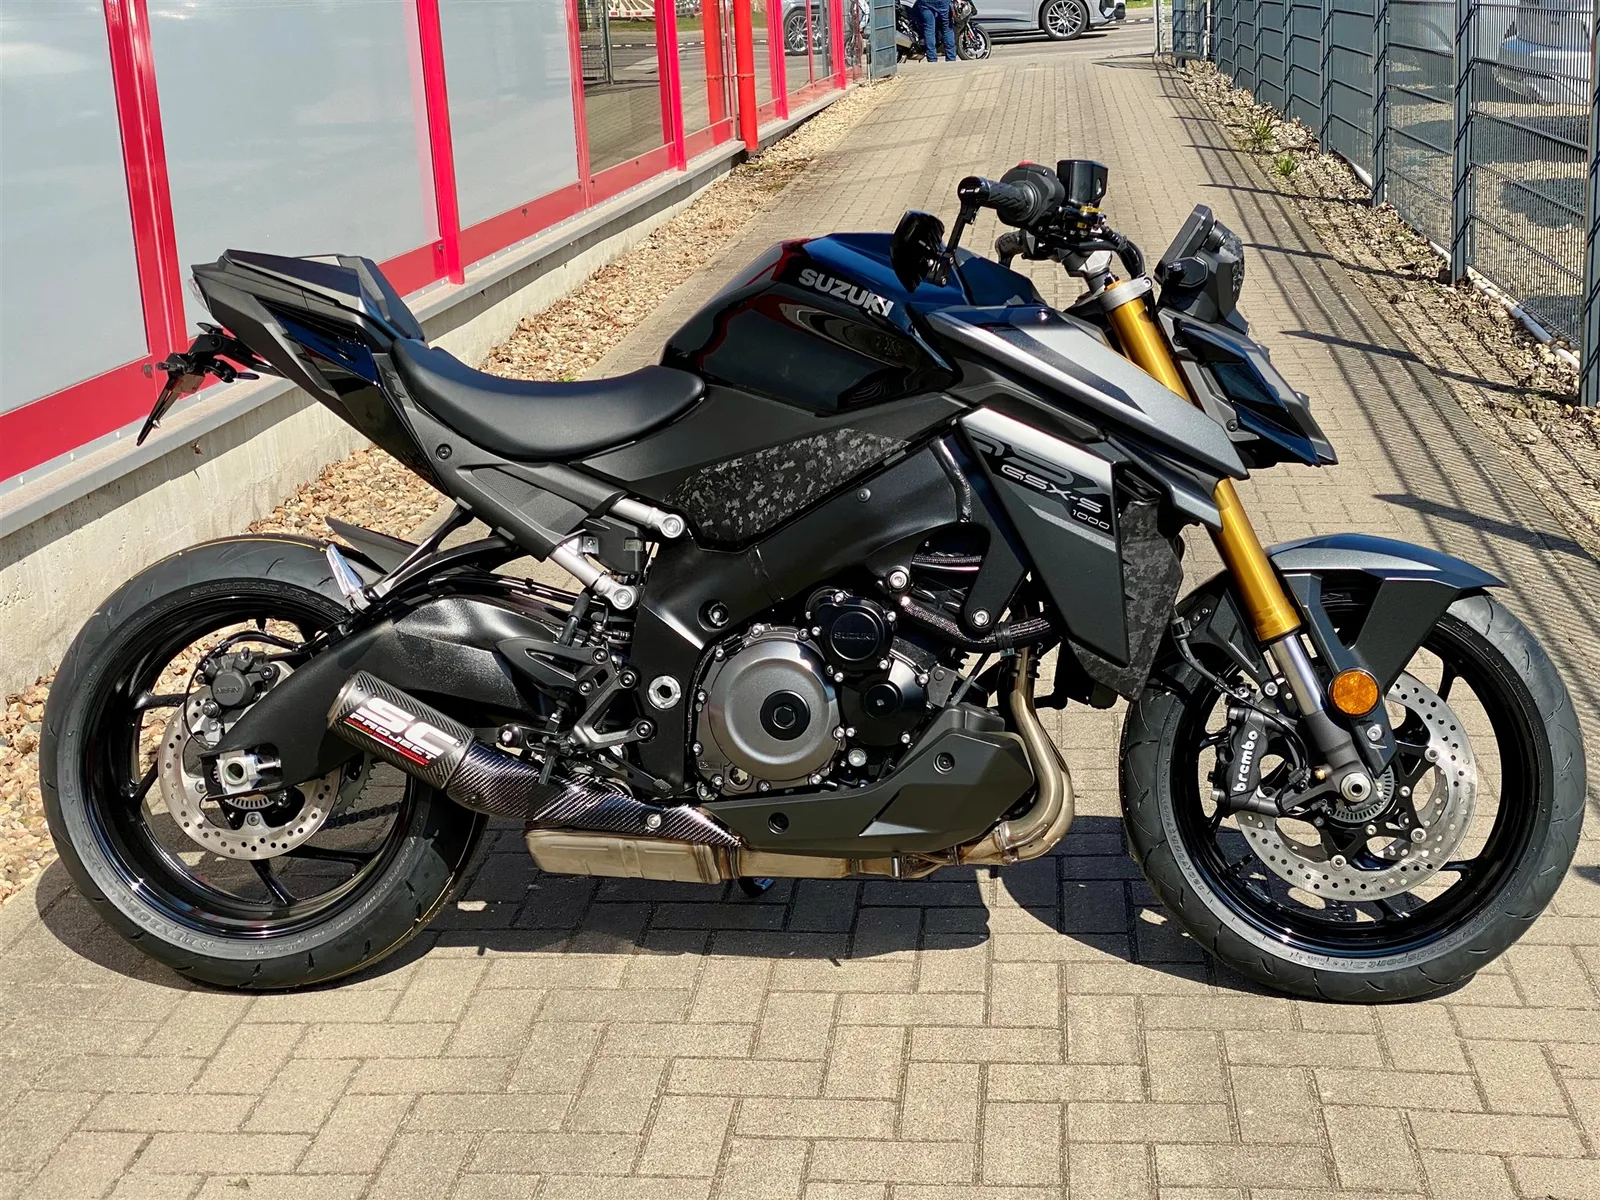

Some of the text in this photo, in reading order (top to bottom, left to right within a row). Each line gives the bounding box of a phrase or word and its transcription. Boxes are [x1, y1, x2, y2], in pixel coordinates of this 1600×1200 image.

[798, 268, 894, 317] SUZUKI
[1001, 464, 1103, 514] GSX-S
[1072, 509, 1110, 530] 1000
[348, 712, 437, 760] PROJECT
[355, 697, 458, 756] SC
[1233, 730, 1258, 792] brembo
